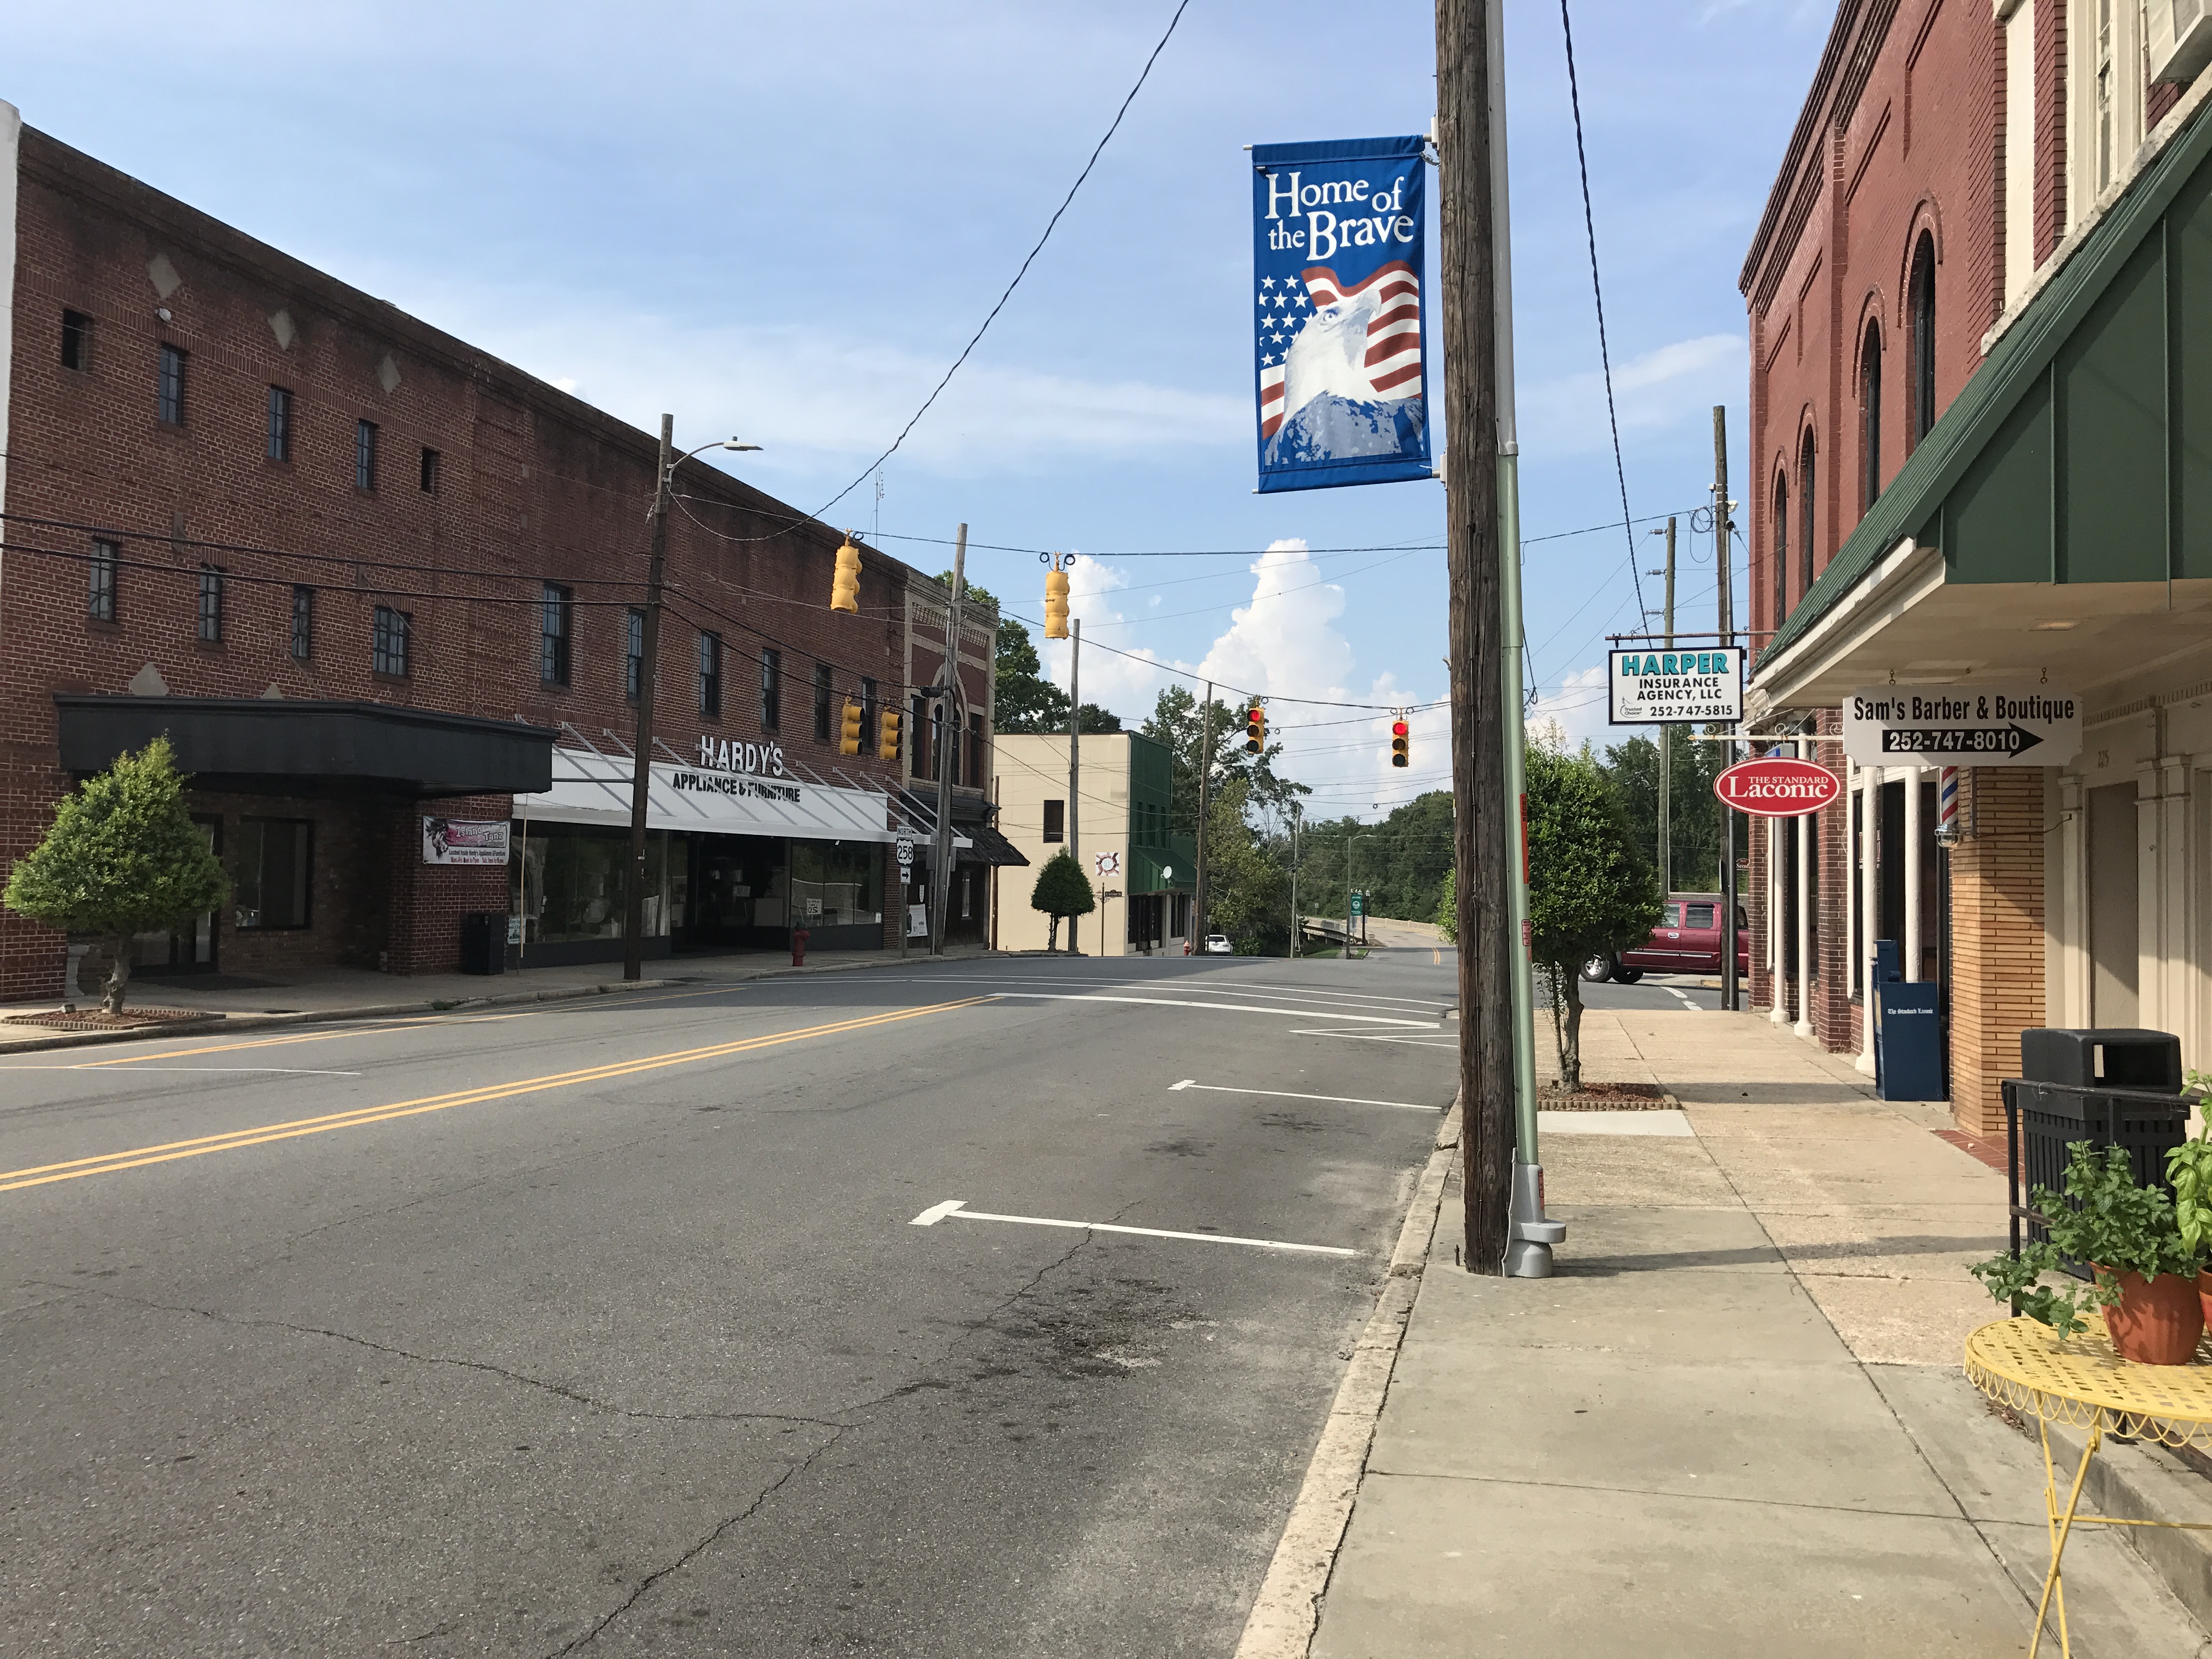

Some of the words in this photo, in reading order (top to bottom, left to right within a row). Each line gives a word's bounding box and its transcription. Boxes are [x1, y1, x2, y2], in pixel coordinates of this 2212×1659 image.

[1265, 172, 1369, 219] Home
[1372, 176, 1404, 212] of
[1268, 219, 1305, 250] the
[1306, 211, 1414, 261] Brave
[1622, 653, 1730, 676] HARPER
[1639, 677, 1719, 689] INSURANCE
[1637, 690, 1696, 701] AGENCY,
[1701, 689, 1722, 699] LLC
[1650, 705, 1733, 716] 252-747-5815
[1854, 697, 1905, 721] Sam's
[1912, 697, 1970, 720] Barber
[1977, 696, 1989, 719] &
[1996, 695, 2074, 724] Boutique
[1889, 731, 2020, 751] 252-747-8010
[701, 735, 783, 776] HARDY'S
[673, 773, 737, 795] APPLIANCE
[739, 781, 746, 796] &
[748, 782, 800, 803] FURNITURE
[1728, 776, 1829, 798] Laconic
[456, 825, 482, 837] Island
[483, 832, 503, 841] Tanz
[898, 845, 913, 860] 258
